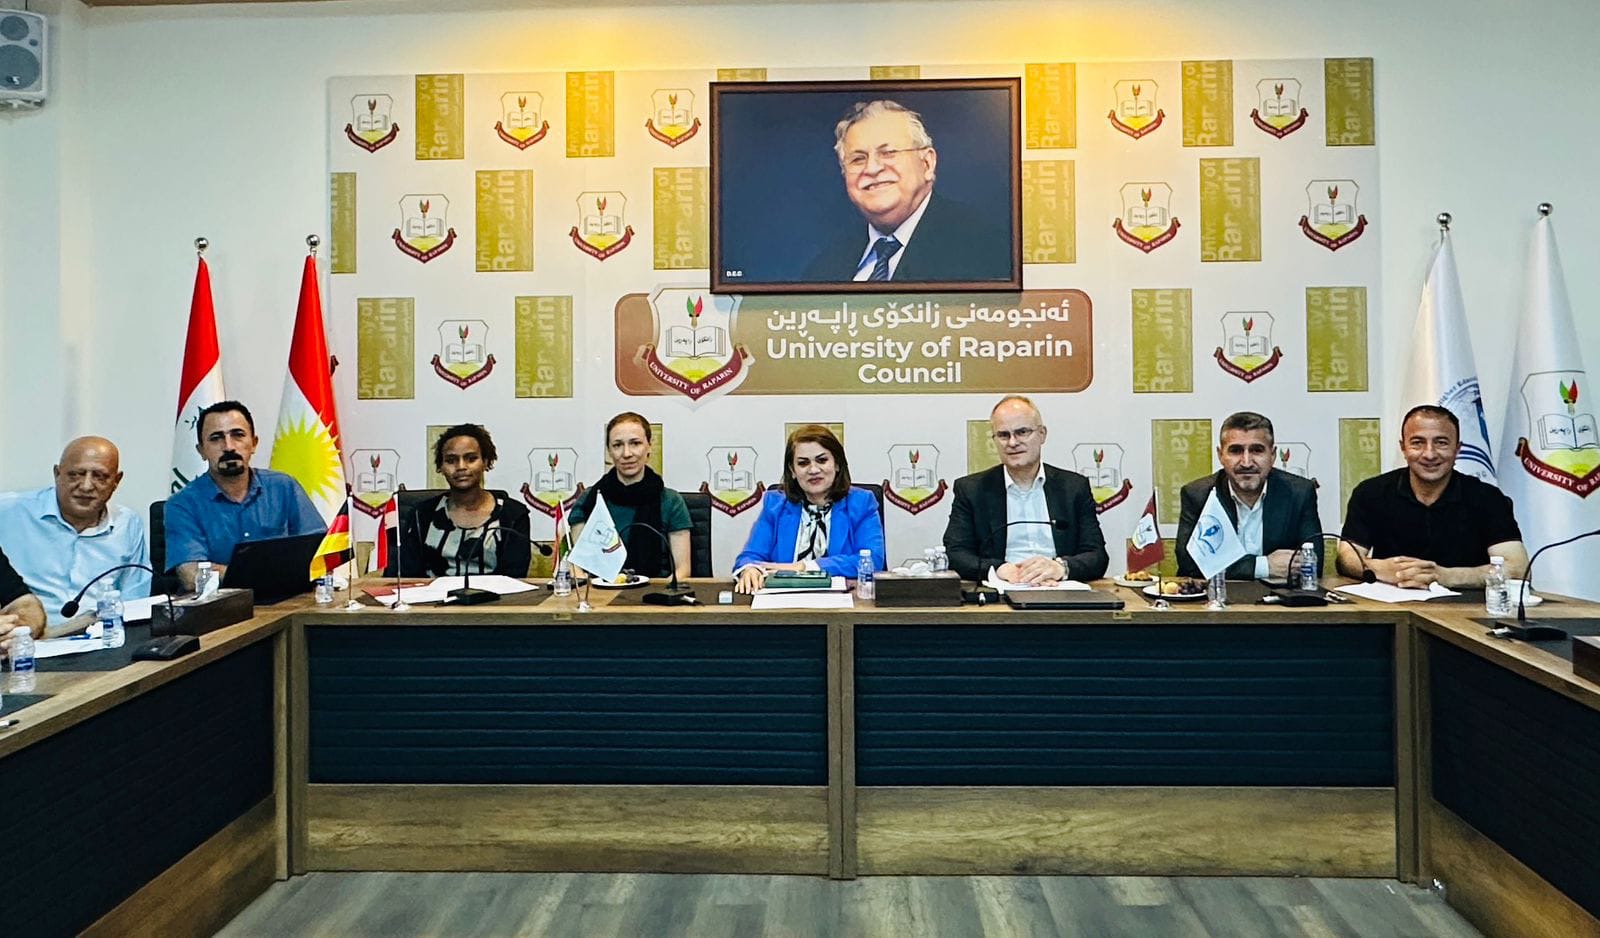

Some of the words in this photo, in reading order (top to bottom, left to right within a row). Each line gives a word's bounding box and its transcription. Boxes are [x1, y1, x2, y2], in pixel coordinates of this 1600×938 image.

[768, 302, 858, 337] ڕاپەڕین
[863, 301, 940, 328] زانکۆی
[946, 299, 1069, 328] ئەنجومەنی
[766, 336, 914, 362] University
[921, 337, 952, 358] of
[960, 334, 1072, 362] Raparin
[650, 362, 688, 390] UNIVERSITY
[702, 368, 733, 389] RAPARIN
[858, 362, 962, 383] Council
[1524, 457, 1575, 488] UNIVERSITY
